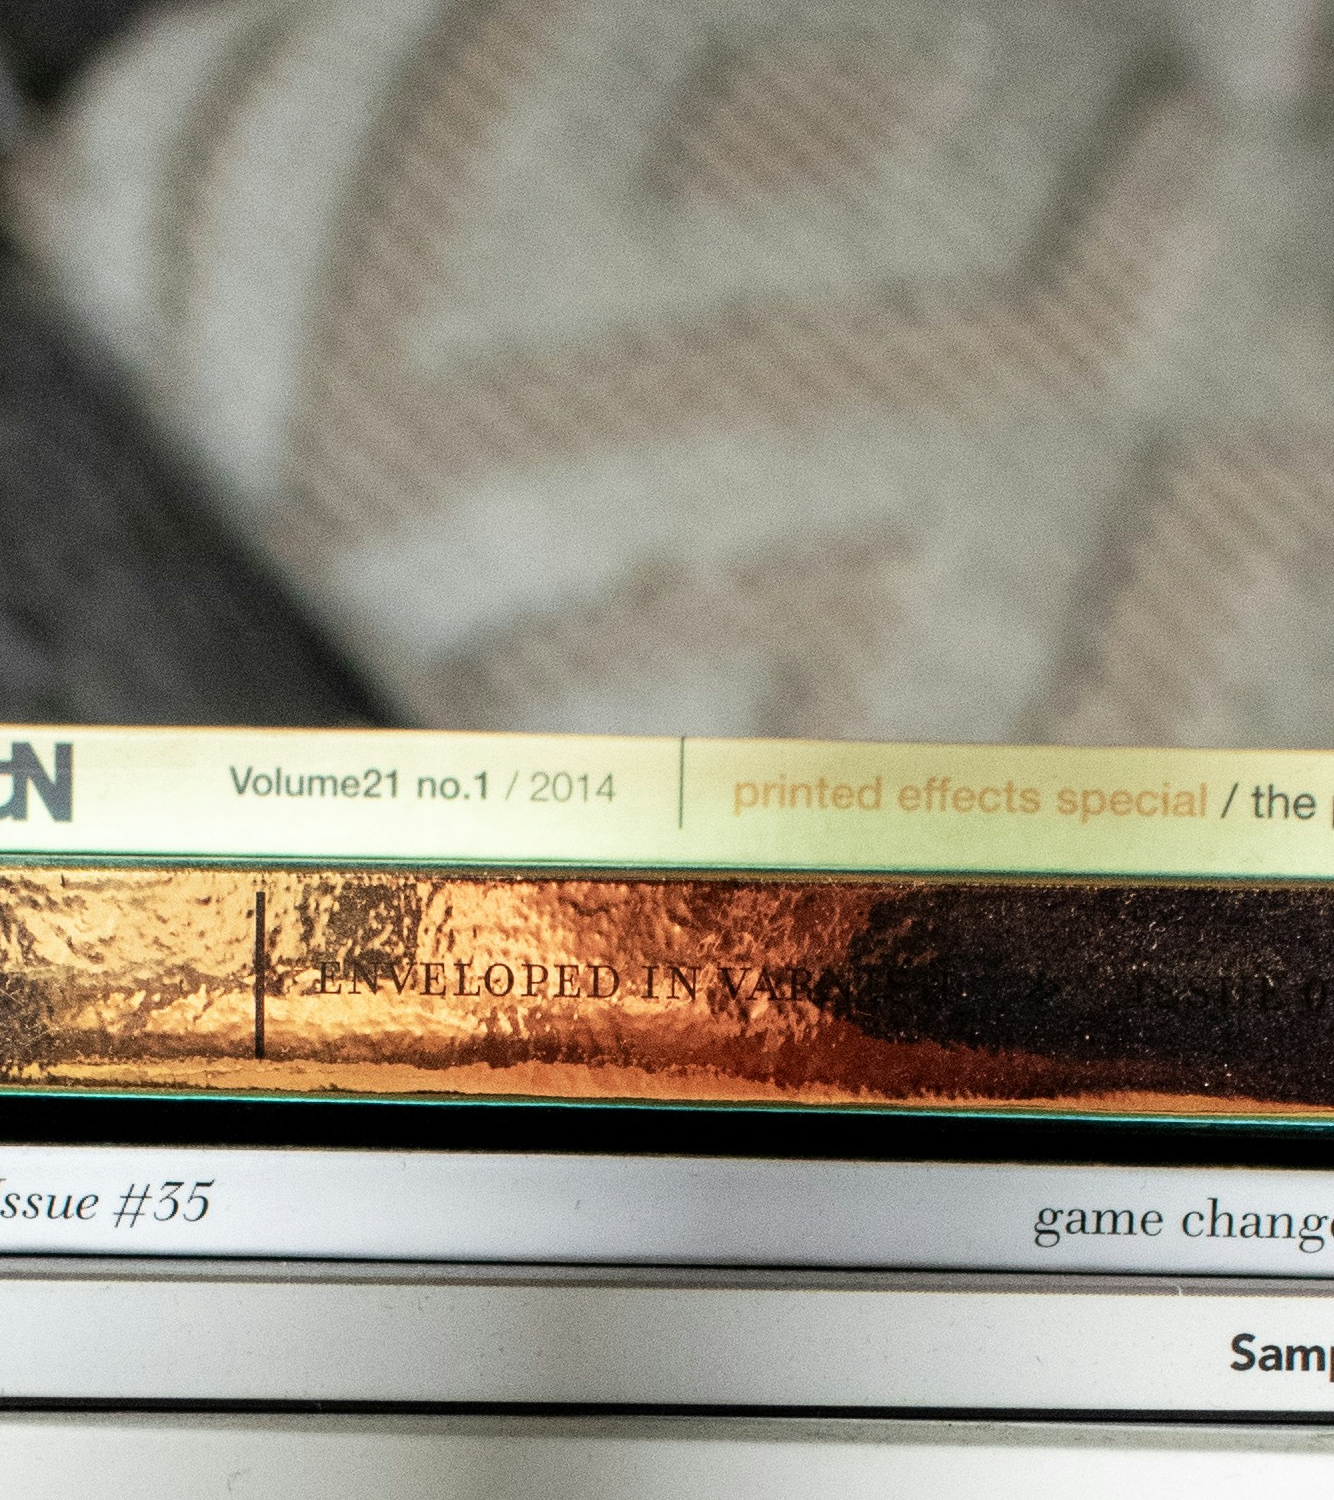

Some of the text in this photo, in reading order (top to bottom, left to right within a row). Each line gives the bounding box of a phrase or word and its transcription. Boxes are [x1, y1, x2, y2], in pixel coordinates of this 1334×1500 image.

[228, 765, 399, 800] Volume21
[416, 770, 489, 802] no.1
[528, 770, 617, 804] 2014
[732, 772, 883, 818] printed
[897, 776, 1041, 815] effects
[1056, 780, 1208, 824] special
[1250, 782, 1317, 822] the
[318, 961, 621, 1000] ENVELOPED
[642, 965, 701, 1001] IN
[113, 1179, 215, 1228] #35
[1033, 1207, 1165, 1248] game
